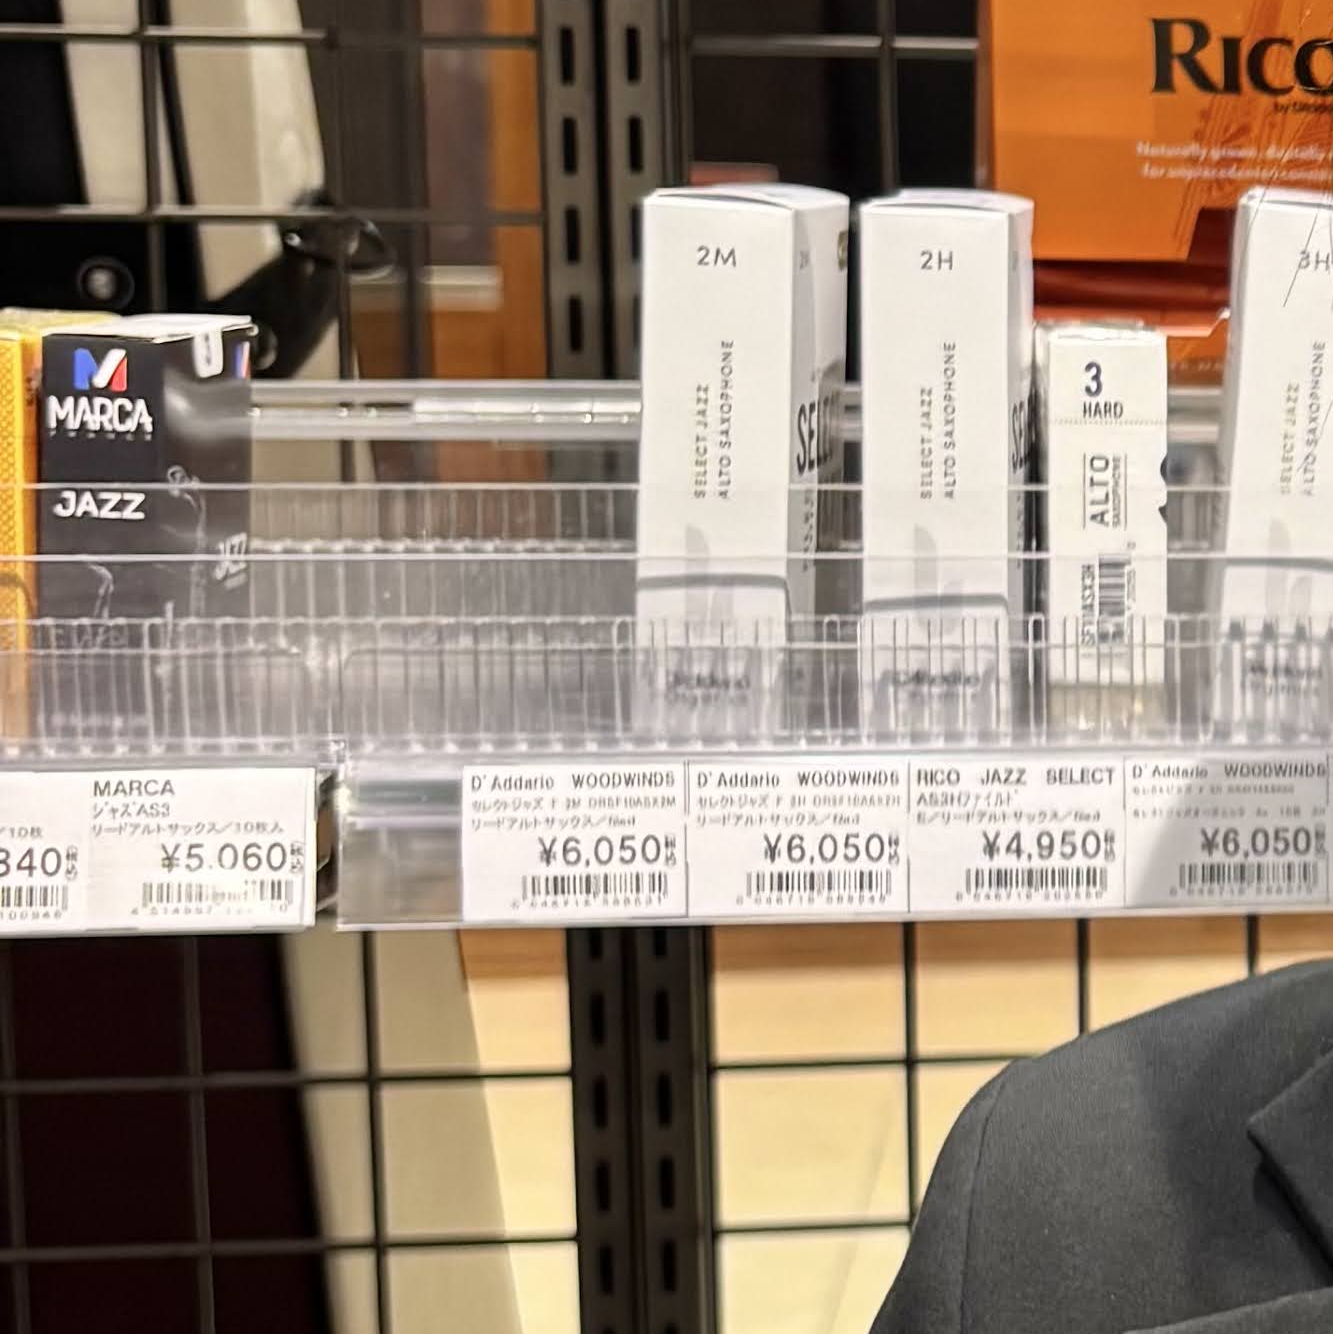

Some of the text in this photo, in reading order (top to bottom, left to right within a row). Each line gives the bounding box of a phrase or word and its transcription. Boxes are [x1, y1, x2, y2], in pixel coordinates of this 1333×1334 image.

[696, 244, 737, 269] 2M
[919, 249, 954, 271] 2H
[1084, 361, 1103, 398] 3
[47, 395, 153, 433] MARCA
[1082, 400, 1124, 419] HARD
[53, 490, 146, 520] JAZZ
[1089, 454, 1110, 528] ALTO
[92, 779, 176, 798] MARCA
[571, 770, 675, 790] WOODWINDS
[796, 770, 900, 789] WOODWINDS
[916, 766, 1115, 787] RICO JAZZ SELECT
[160, 841, 287, 873] ¥5,060
[538, 834, 661, 868] ¥6,050
[763, 833, 886, 865] ¥6,050
[982, 828, 1102, 863] ¥4,950
[1200, 826, 1312, 858] ¥6,050
